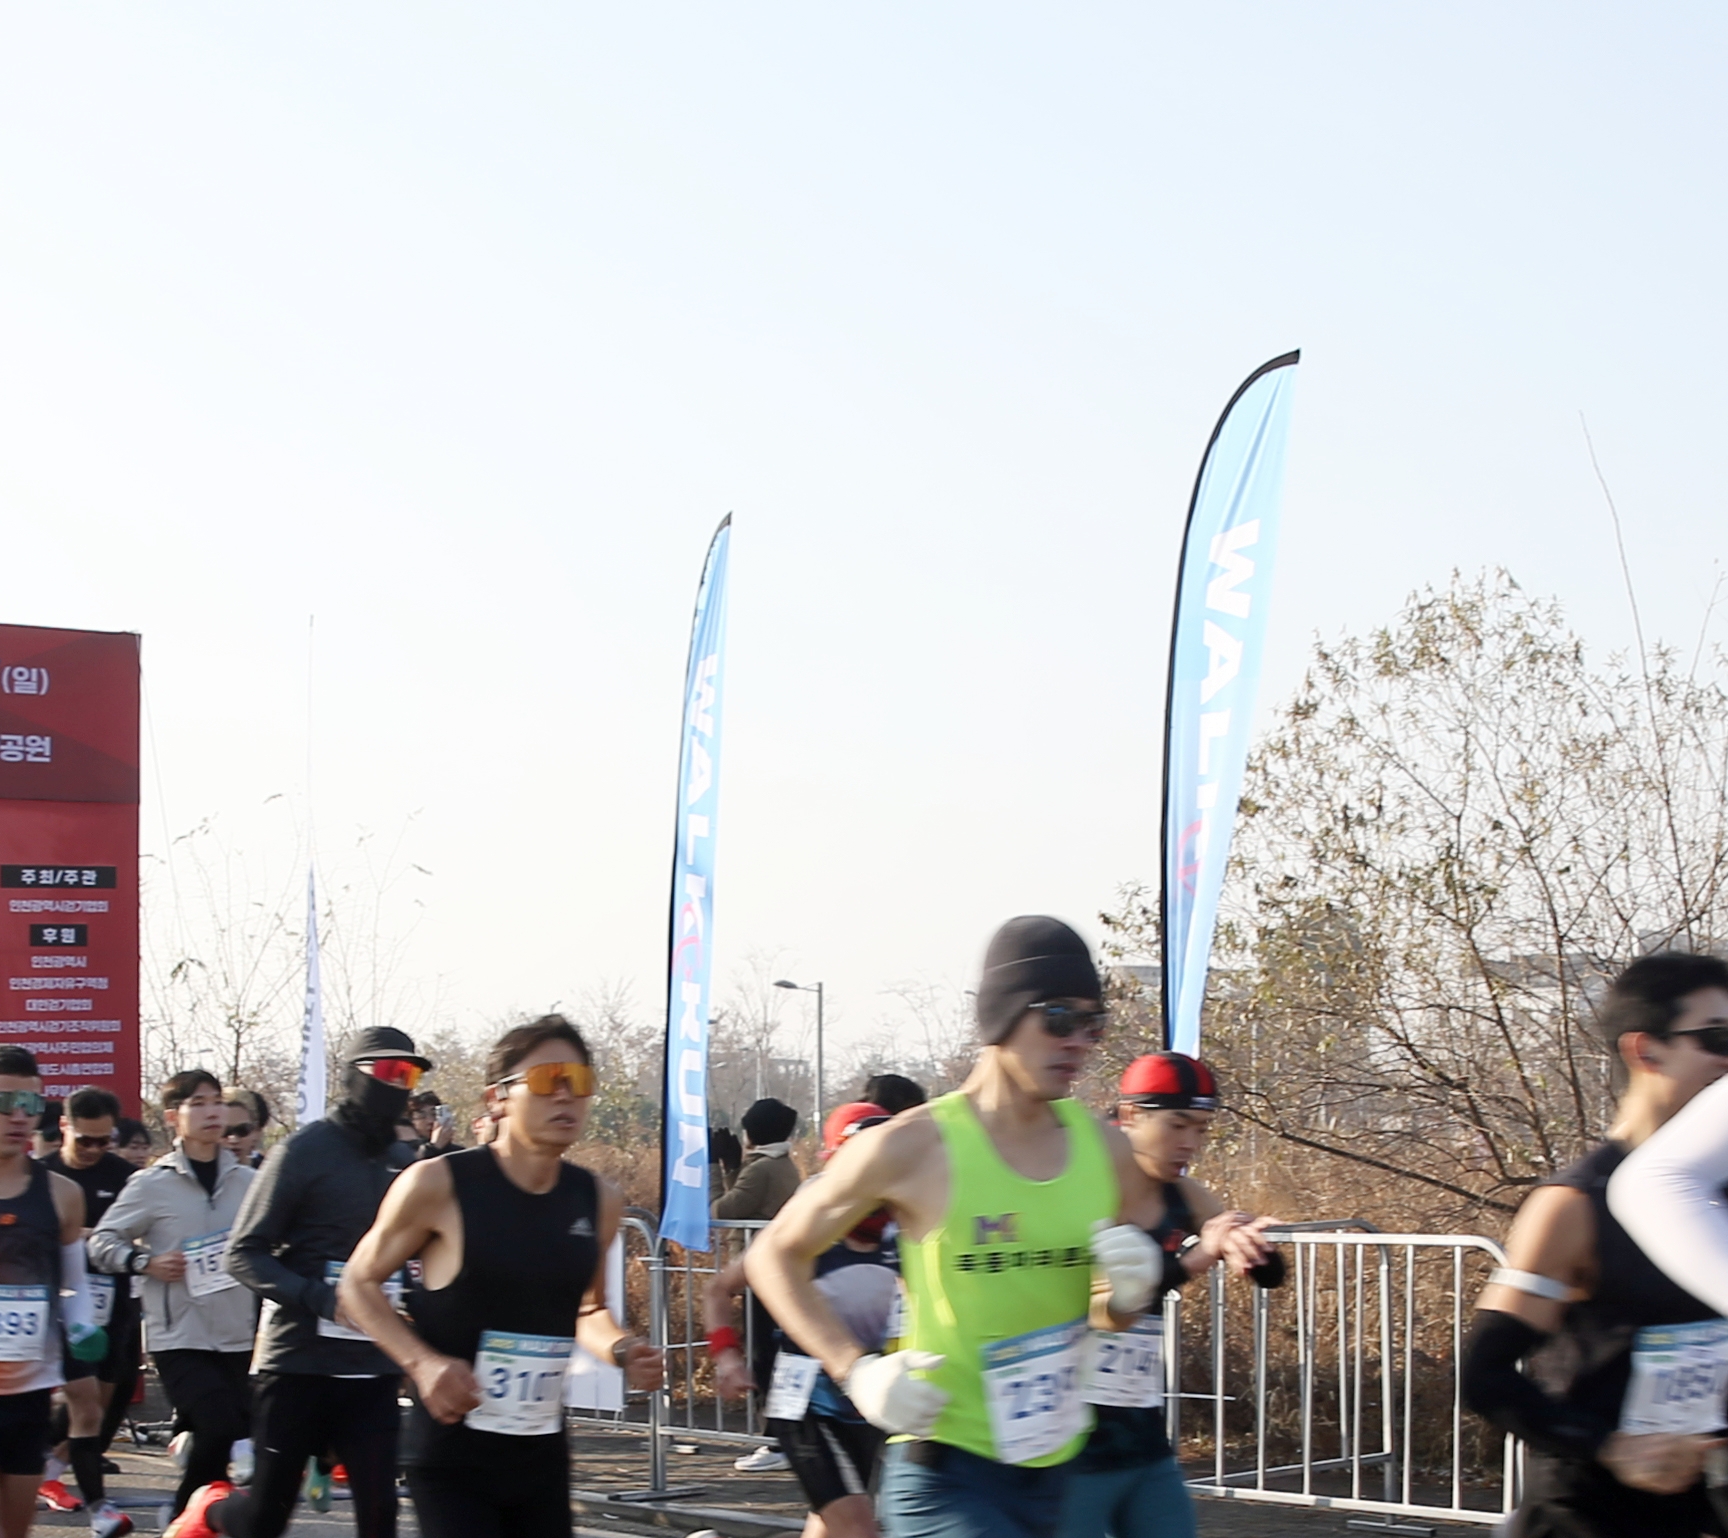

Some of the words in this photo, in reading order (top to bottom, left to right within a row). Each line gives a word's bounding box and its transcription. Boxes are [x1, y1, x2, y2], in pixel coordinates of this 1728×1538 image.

[683, 653, 718, 936] WALK
[30, 955, 88, 969] 인천광역시
[671, 980, 704, 1188] RUN
